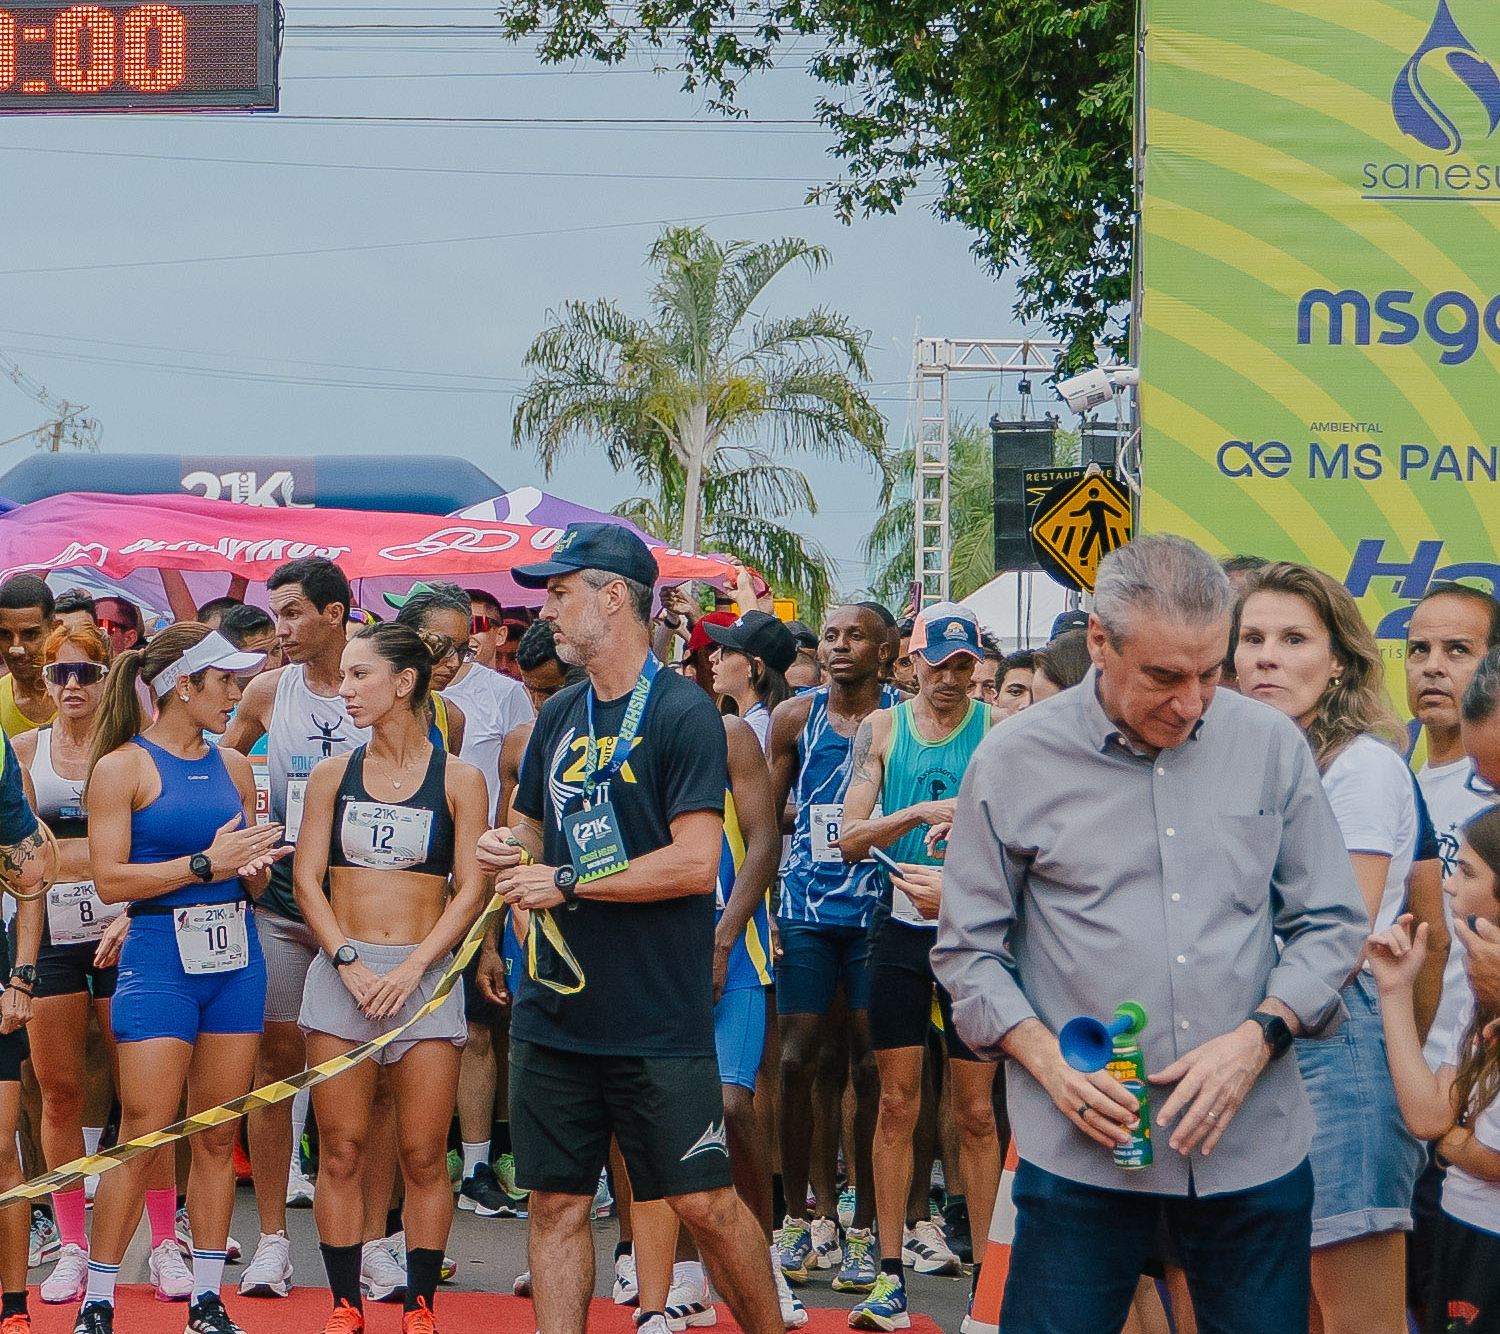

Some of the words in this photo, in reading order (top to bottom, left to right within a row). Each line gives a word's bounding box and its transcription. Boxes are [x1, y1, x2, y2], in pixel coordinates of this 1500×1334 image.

[1309, 422, 1383, 433] AMBIENTAL
[1309, 442, 1383, 481] MS
[370, 825, 395, 849] 12
[80, 900, 94, 922] 8
[205, 926, 228, 950] 10
